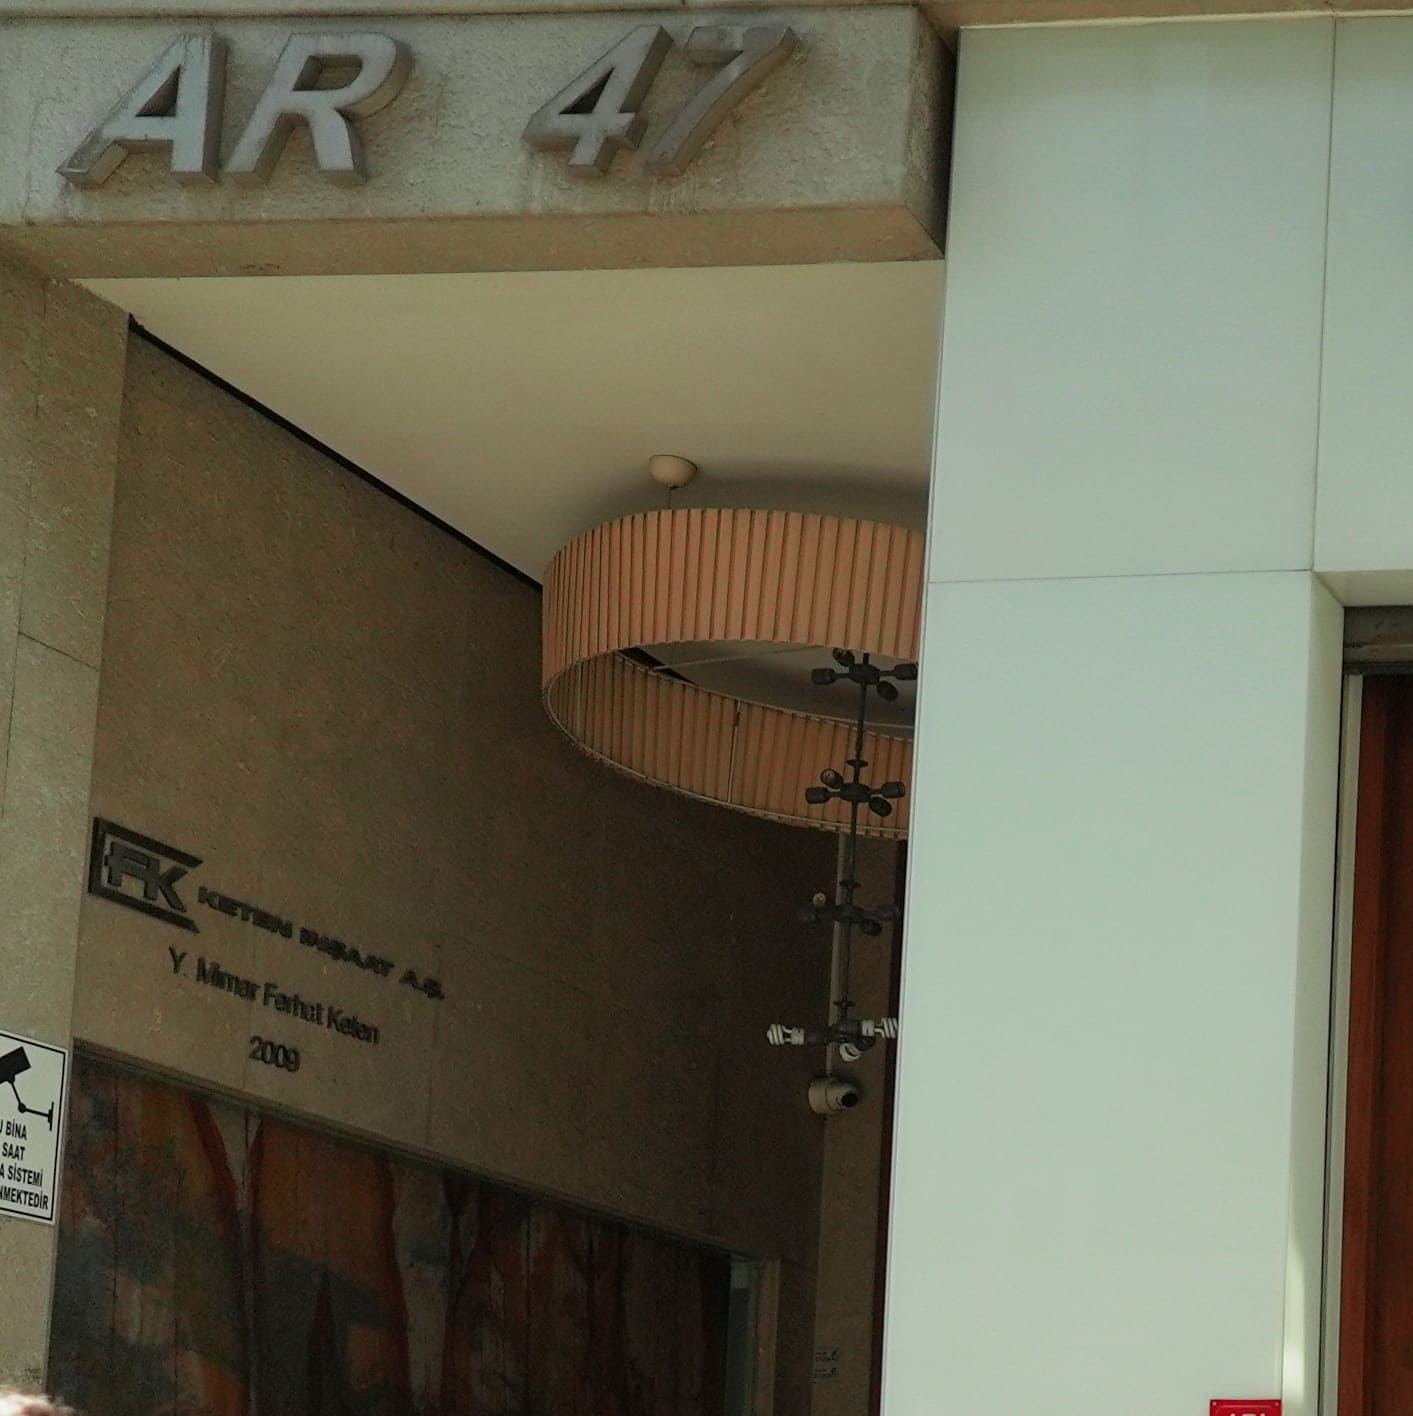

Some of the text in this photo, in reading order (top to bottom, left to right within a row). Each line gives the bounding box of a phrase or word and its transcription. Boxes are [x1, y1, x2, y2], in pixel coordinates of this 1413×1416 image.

[56, 24, 798, 187] AR 47
[248, 1035, 301, 1073] 2009
[5, 1119, 27, 1141] BİNA
[2, 1142, 26, 1161] SAAT
[7, 1163, 43, 1187] SİSTEMİ
